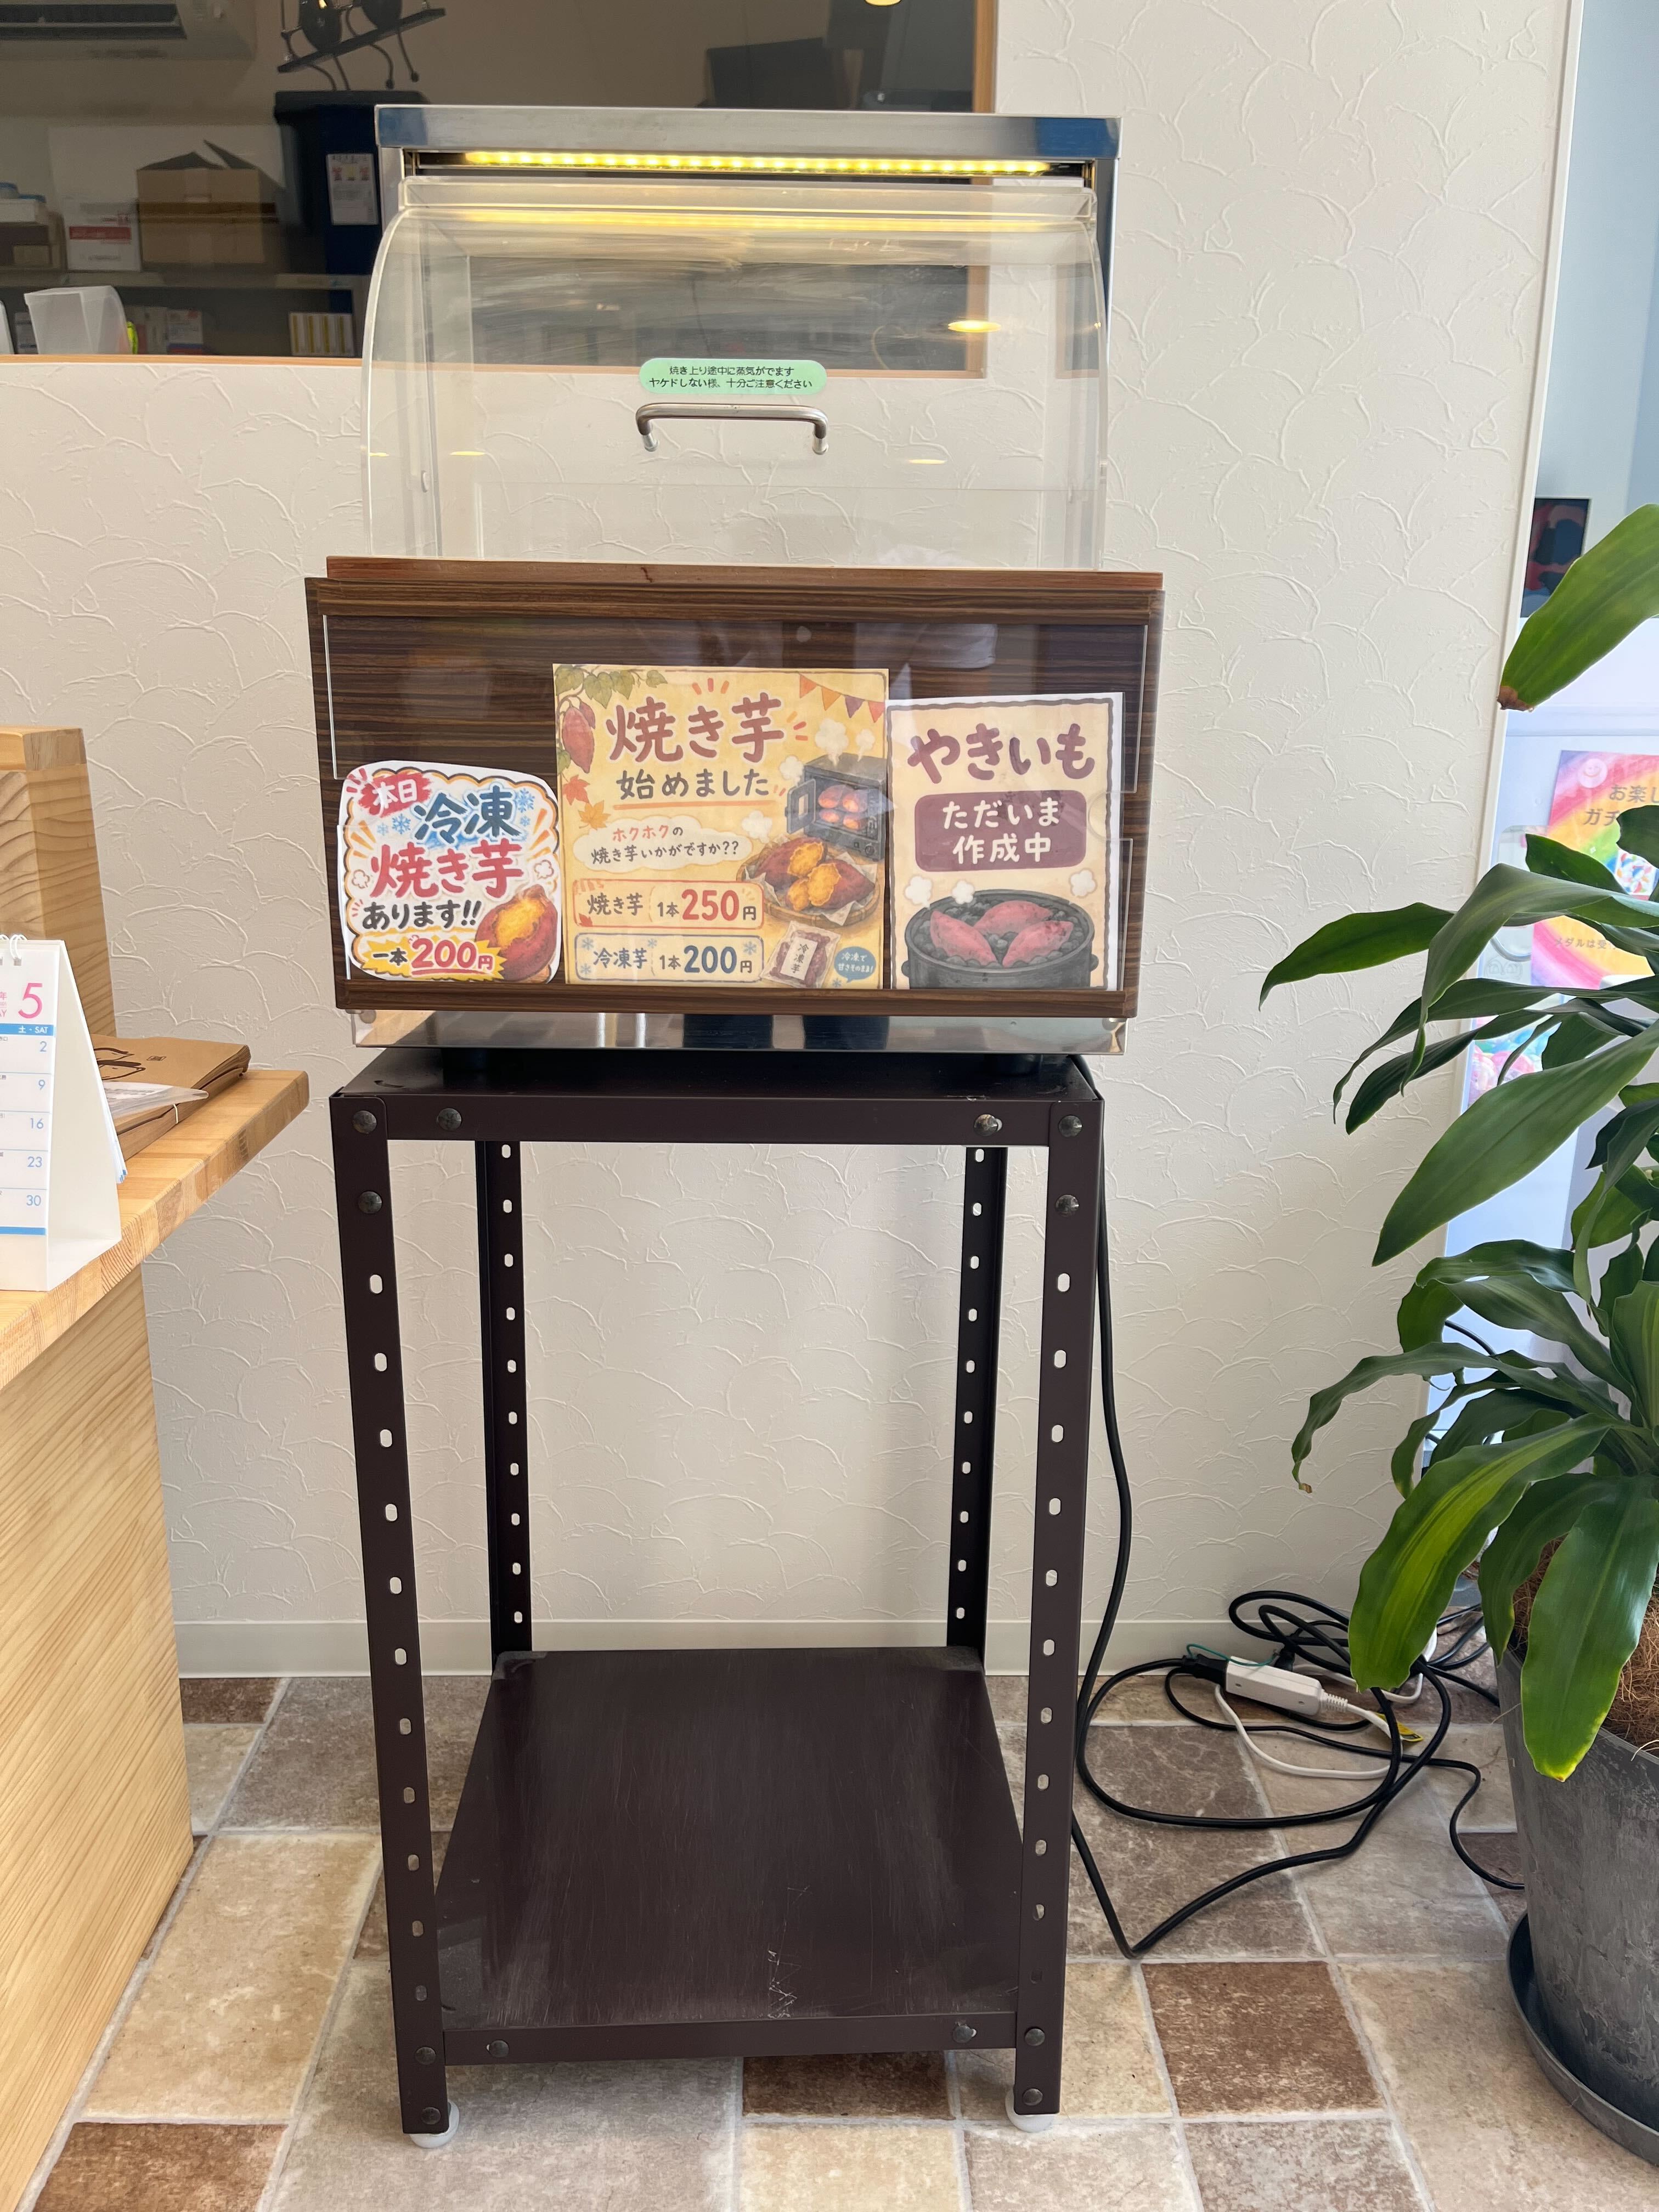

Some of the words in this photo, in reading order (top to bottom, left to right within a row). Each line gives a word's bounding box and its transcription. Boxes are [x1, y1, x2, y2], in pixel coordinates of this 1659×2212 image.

[649, 377, 812, 388] ヤケドしない様、十分ご注意ください
[669, 366, 794, 376] 焼き上り途中に蒸気がでます
[606, 692, 785, 763] 焼き芋
[907, 723, 1096, 785] やきいも
[373, 779, 417, 806] 本日
[616, 768, 769, 800] 始めました
[414, 785, 521, 844] 冷凍
[943, 797, 1059, 830] ただいま
[612, 825, 684, 842] ホクホクの
[952, 832, 1051, 865] 作成中
[369, 838, 524, 899] 焼き芋
[362, 899, 483, 930] あります!!
[586, 893, 644, 917] 焼き芋
[592, 947, 648, 969] 冷凍芋
[18, 983, 43, 1019] 5
[40, 1041, 47, 1052] 2
[38, 1080, 46, 1091] 9
[30, 1118, 44, 1129] 16
[27, 1156, 42, 1167] 23
[26, 1195, 41, 1206] 30
